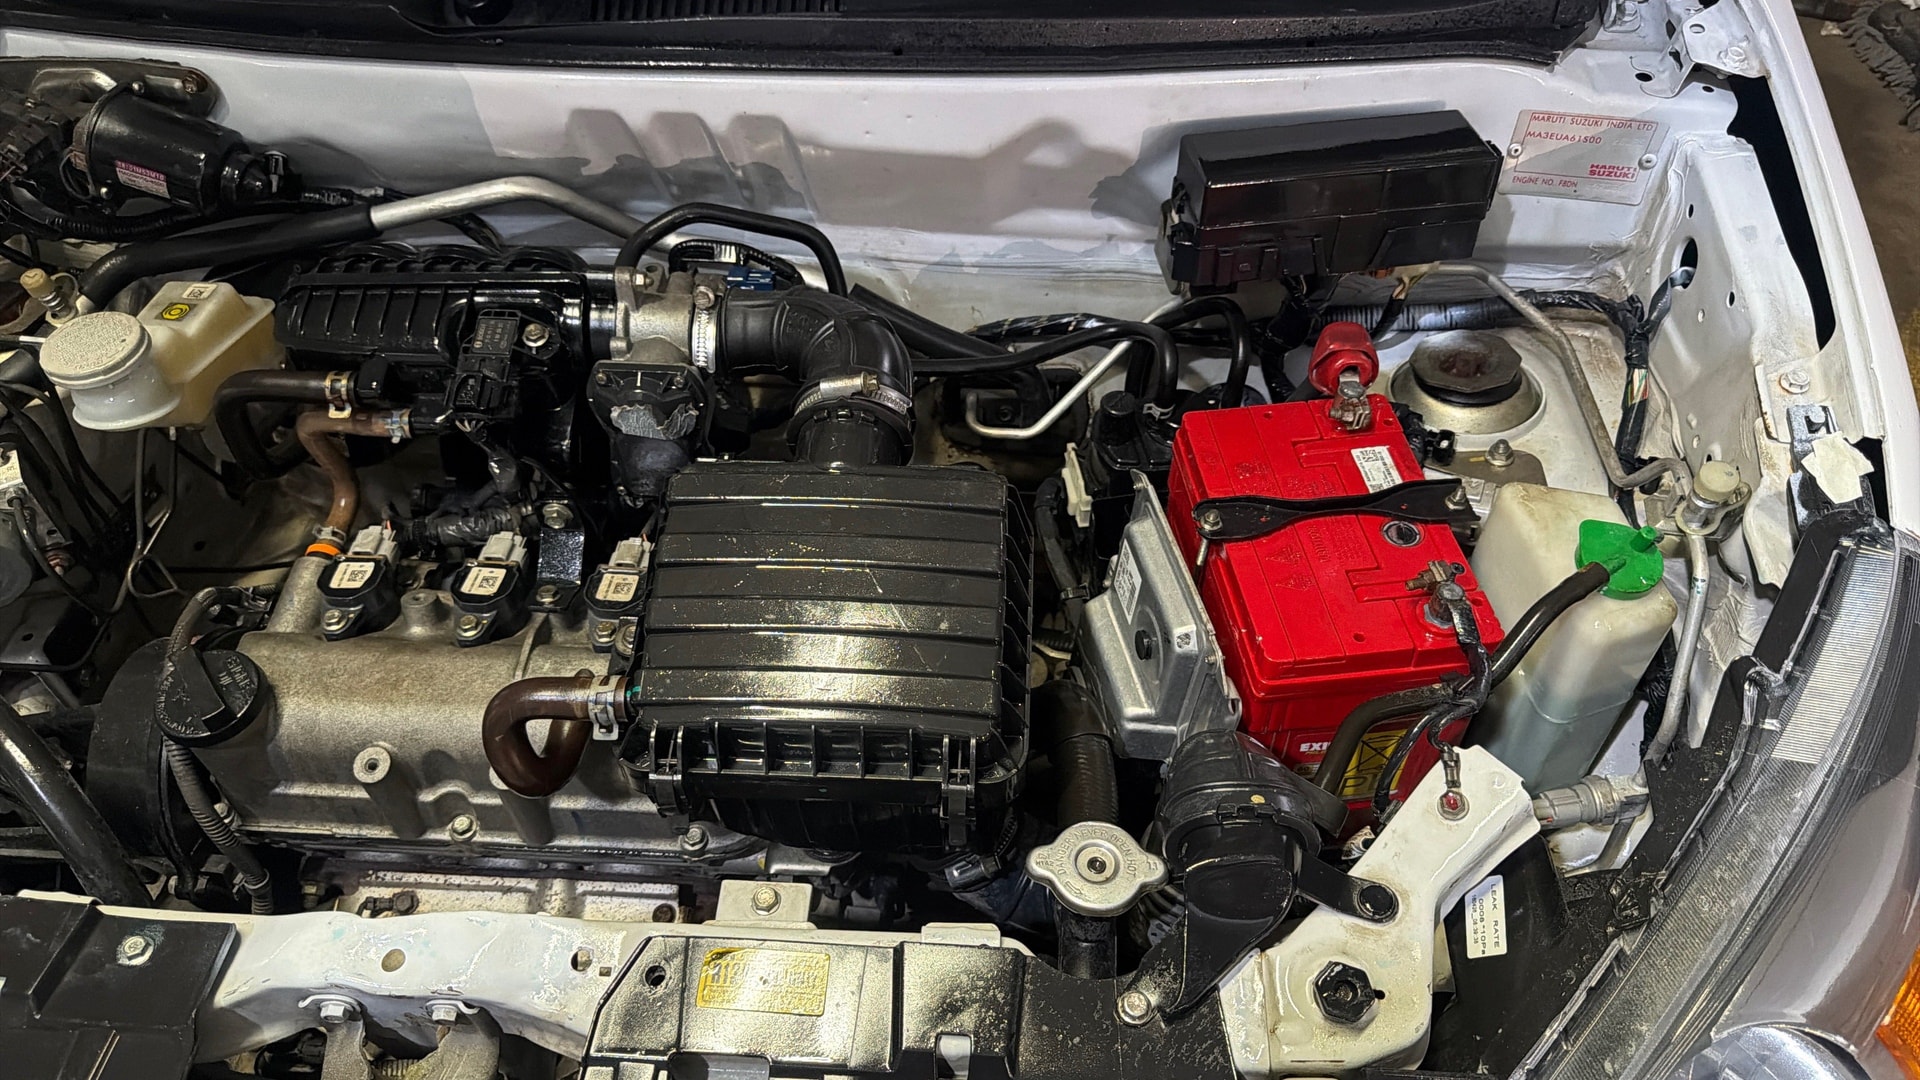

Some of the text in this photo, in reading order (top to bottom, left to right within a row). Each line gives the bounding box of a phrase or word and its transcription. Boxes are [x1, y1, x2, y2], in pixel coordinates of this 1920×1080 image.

[1532, 115, 1654, 132] MARUTI SUZUKI INDIA LTD
[1590, 163, 1637, 172] MARUTI
[1512, 175, 1539, 185] ENGINE
[1589, 169, 1636, 180] SUZUKI
[1300, 742, 1332, 752] EXI
[1056, 837, 1075, 876] DANGER
[1074, 828, 1108, 841] NEVER
[1110, 833, 1134, 857] OPEN
[1127, 859, 1138, 878] HOT
[1490, 883, 1498, 911] LEAK
